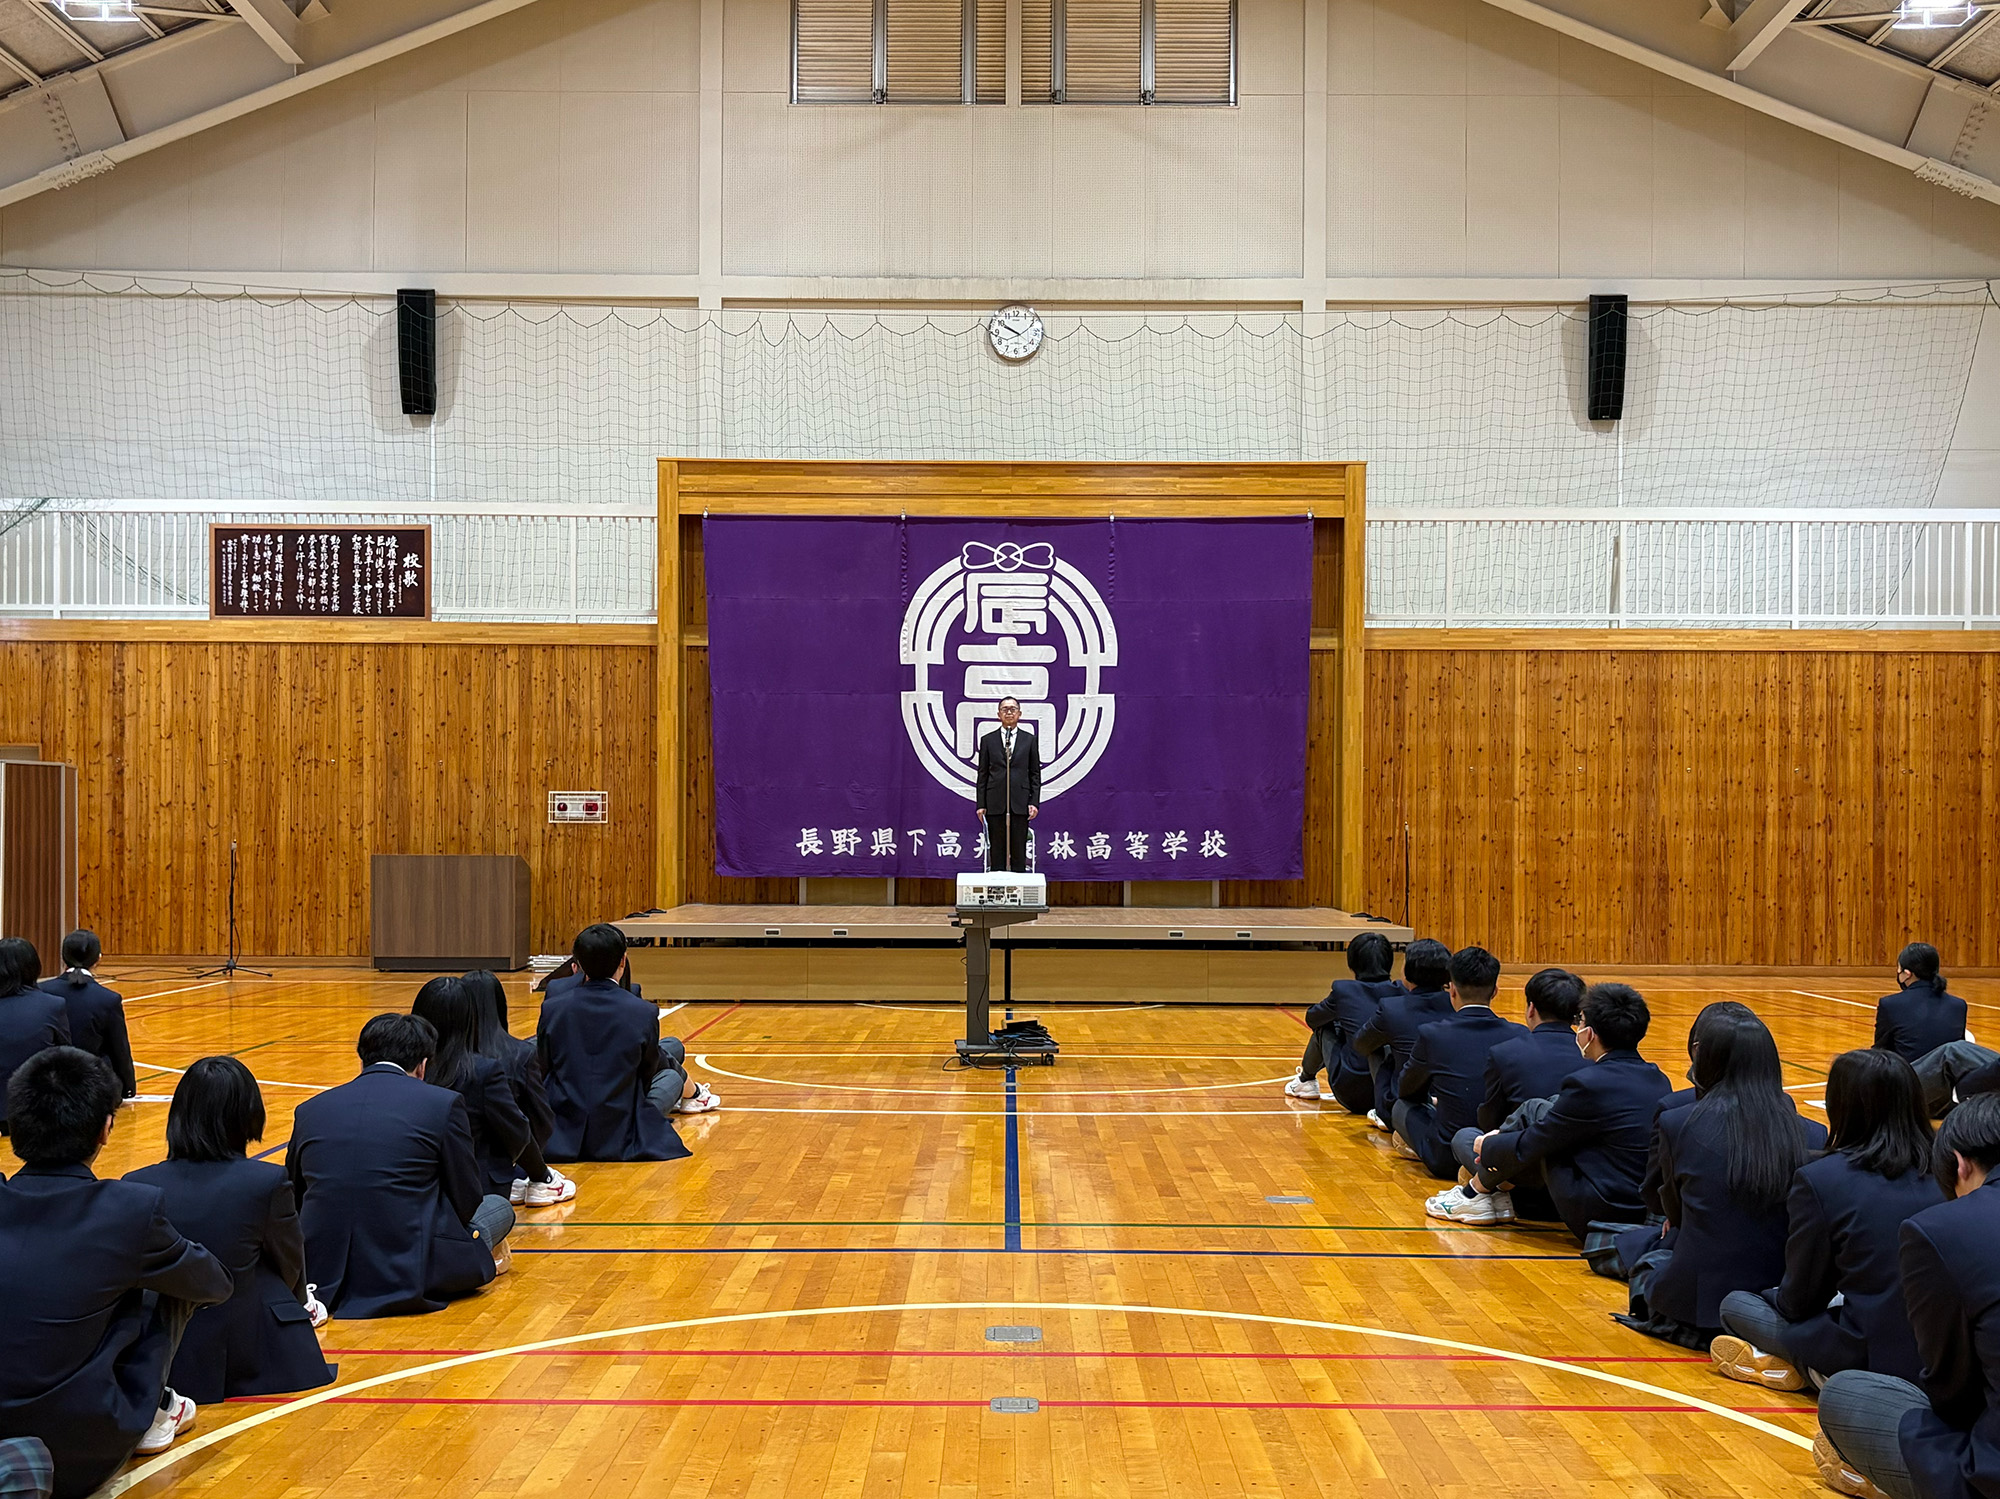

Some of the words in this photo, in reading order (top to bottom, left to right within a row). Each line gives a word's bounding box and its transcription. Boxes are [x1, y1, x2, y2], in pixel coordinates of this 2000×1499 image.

[994, 328, 1000, 336] 9
[402, 552, 423, 587] 校歌
[795, 826, 1230, 861] 長野県下高林高等学校
